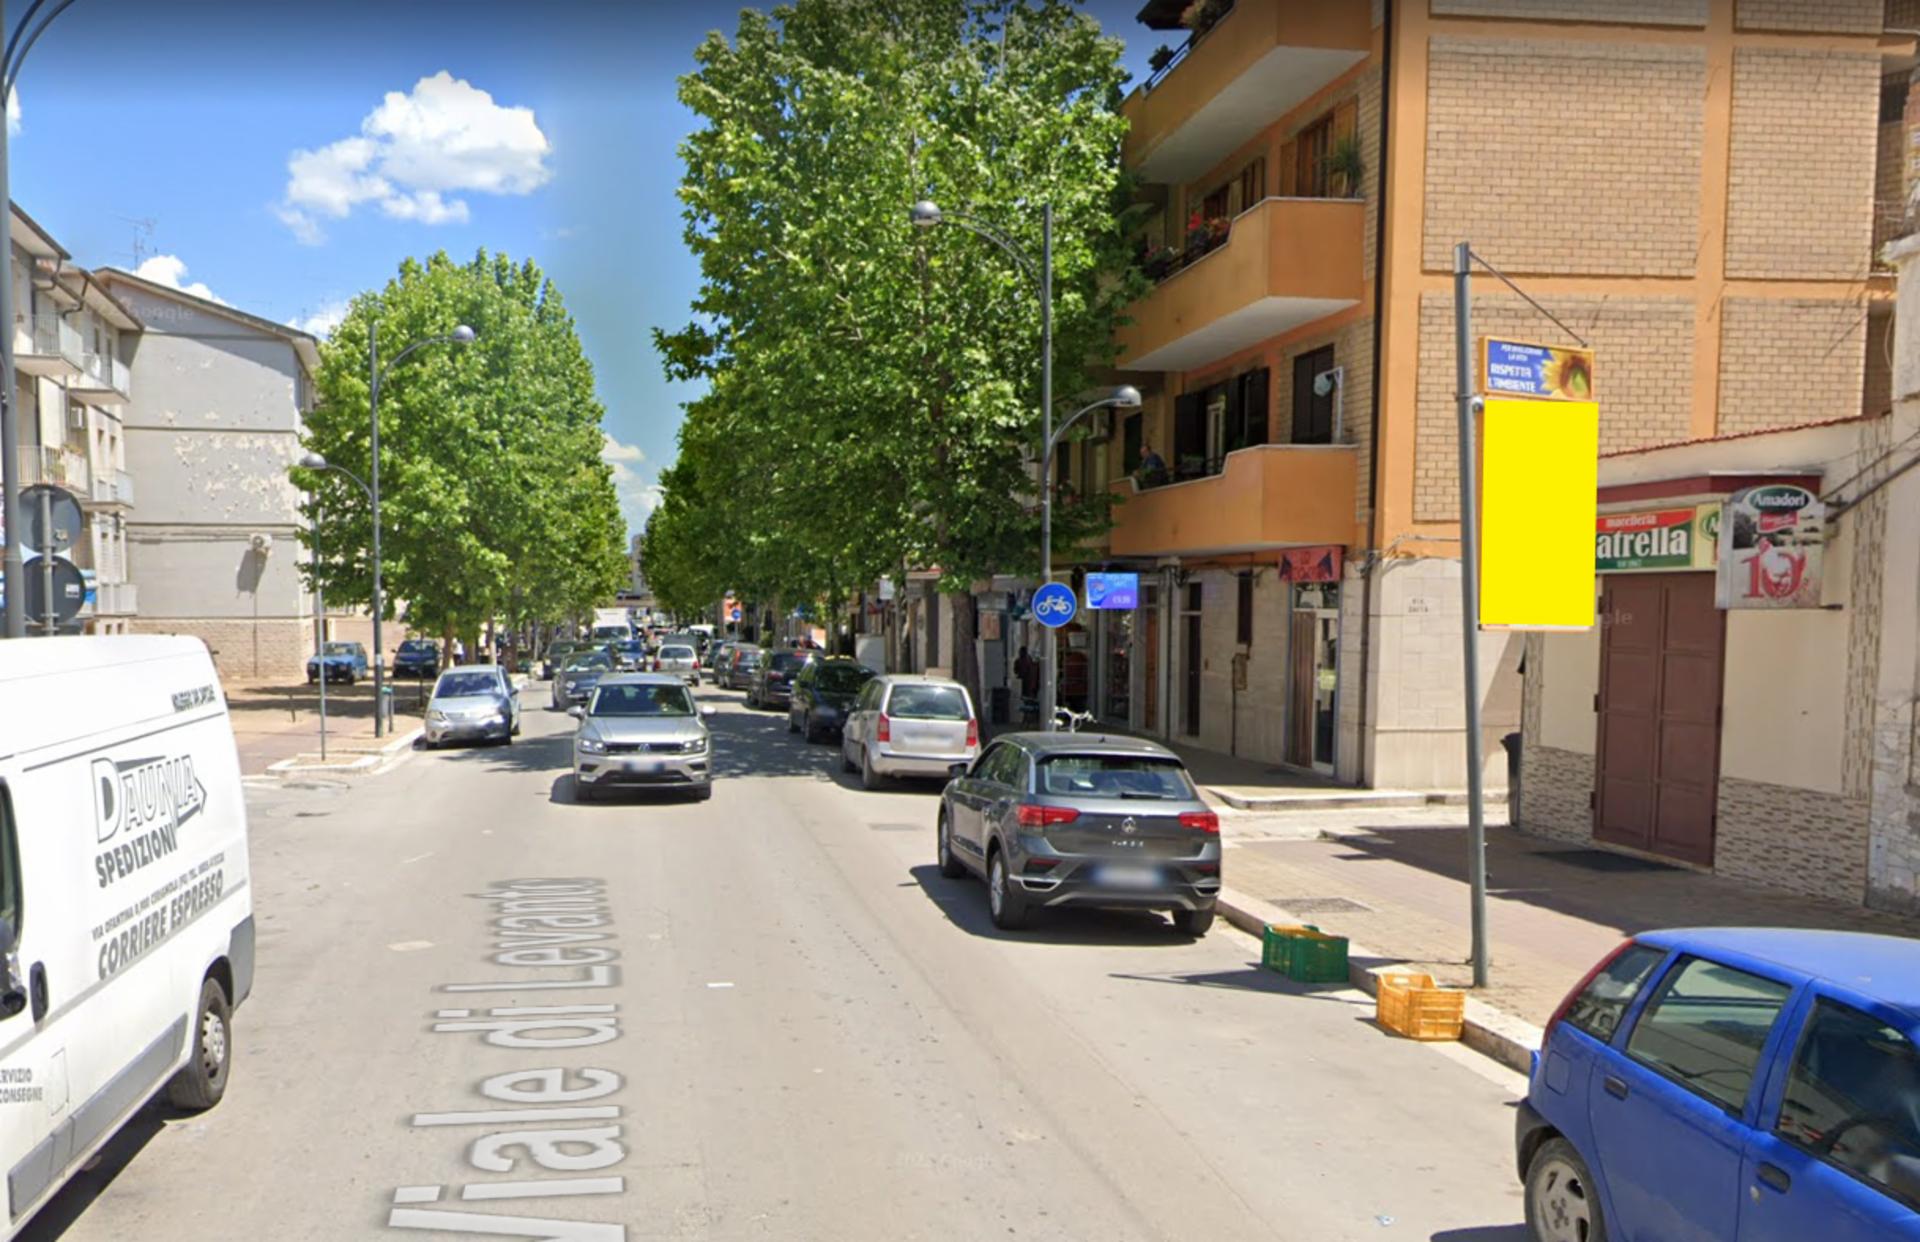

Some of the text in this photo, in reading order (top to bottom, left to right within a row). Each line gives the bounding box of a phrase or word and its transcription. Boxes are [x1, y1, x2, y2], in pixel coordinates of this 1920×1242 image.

[1491, 363, 1532, 378] RISPETTA
[1754, 493, 1806, 506] Amadori
[95, 823, 179, 888] SPEDIZIONI
[98, 867, 223, 981] CORRIERE ESPRESSO
